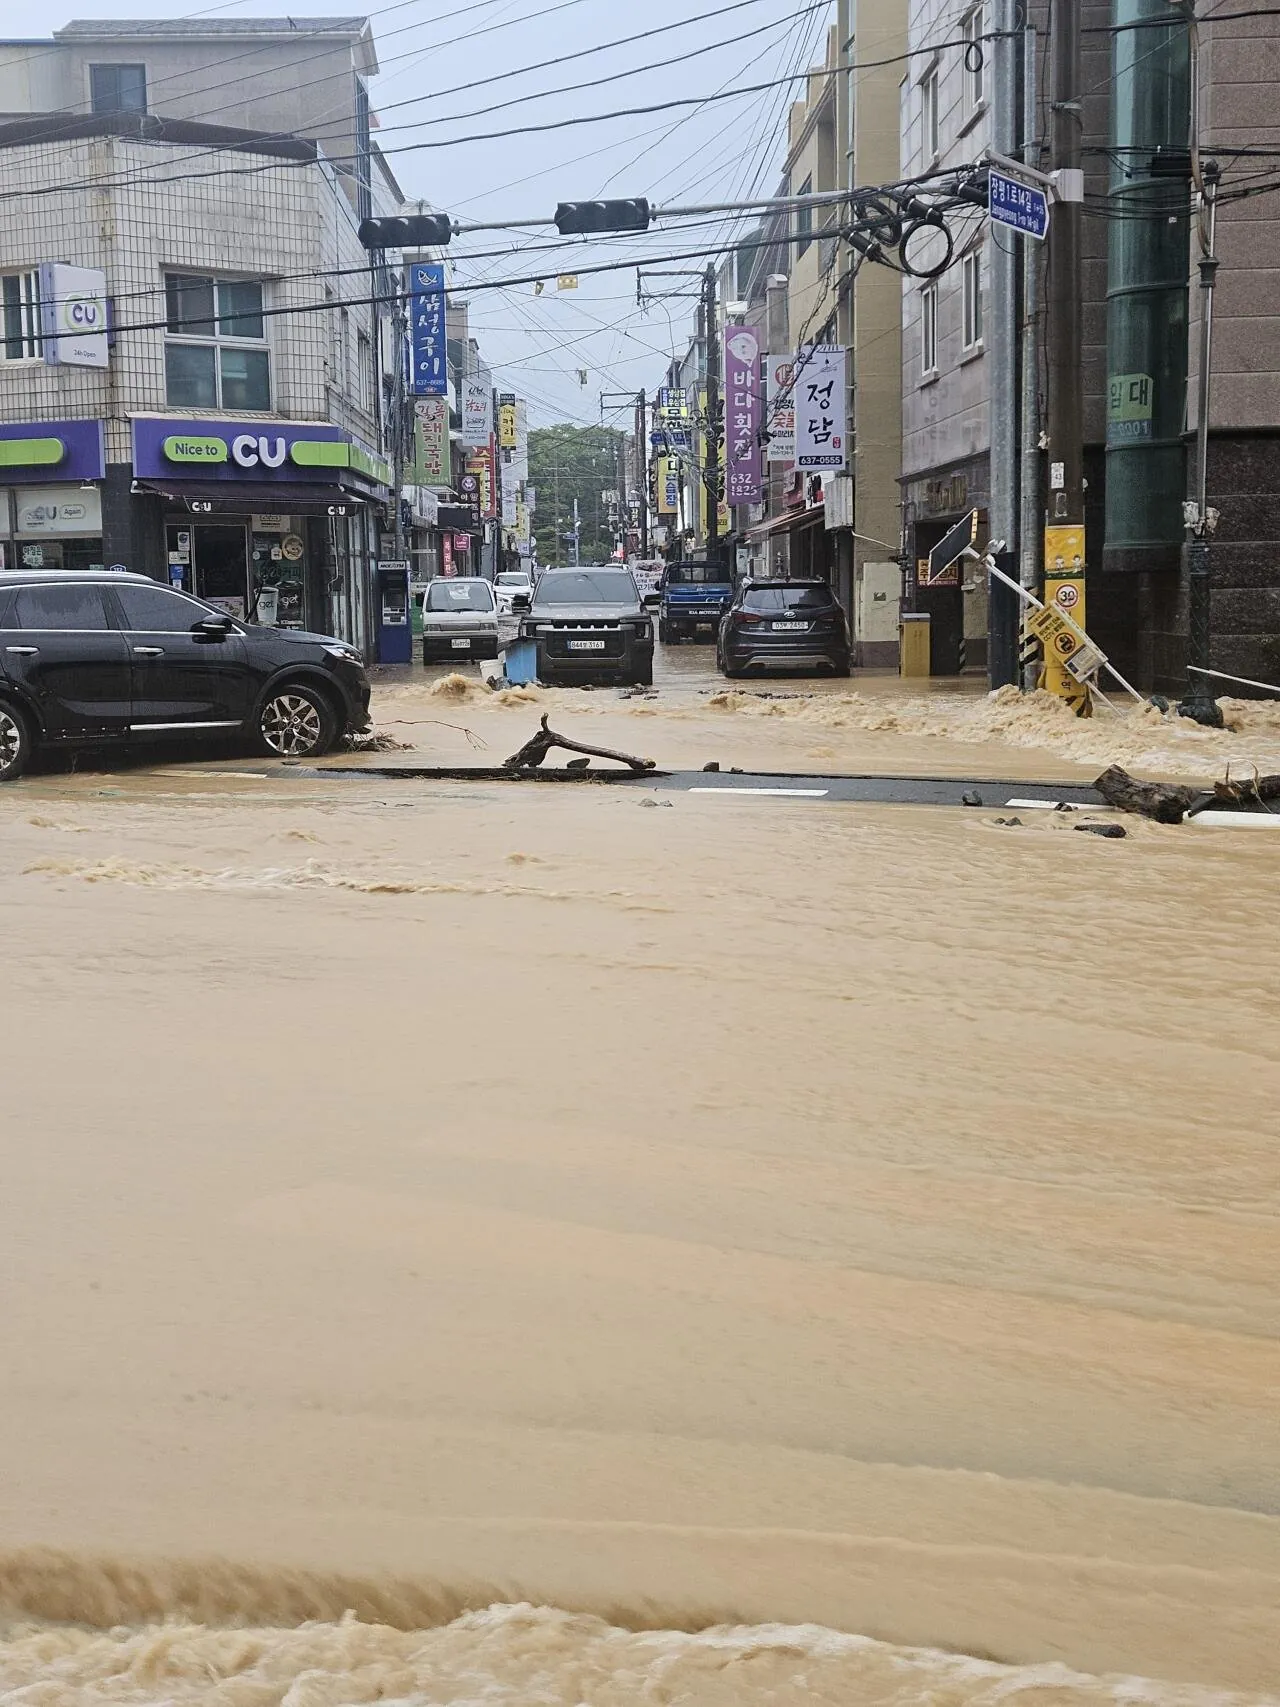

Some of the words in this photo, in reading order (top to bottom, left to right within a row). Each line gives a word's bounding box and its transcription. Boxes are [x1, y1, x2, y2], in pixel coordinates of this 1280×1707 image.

[72, 303, 96, 323] CU
[418, 292, 440, 375] 삼성구이
[1110, 378, 1149, 409] 임대
[733, 370, 755, 461] 바다횟집
[807, 380, 833, 444] 정담
[175, 442, 202, 456] Nice
[205, 443, 218, 456] to
[232, 434, 286, 468] CU
[422, 422, 442, 475] 돼지국밥
[800, 456, 841, 466] 637-0555
[730, 473, 753, 485] 632
[63, 507, 81, 516] Again
[259, 600, 275, 610] get
[1060, 590, 1075, 602] 30
